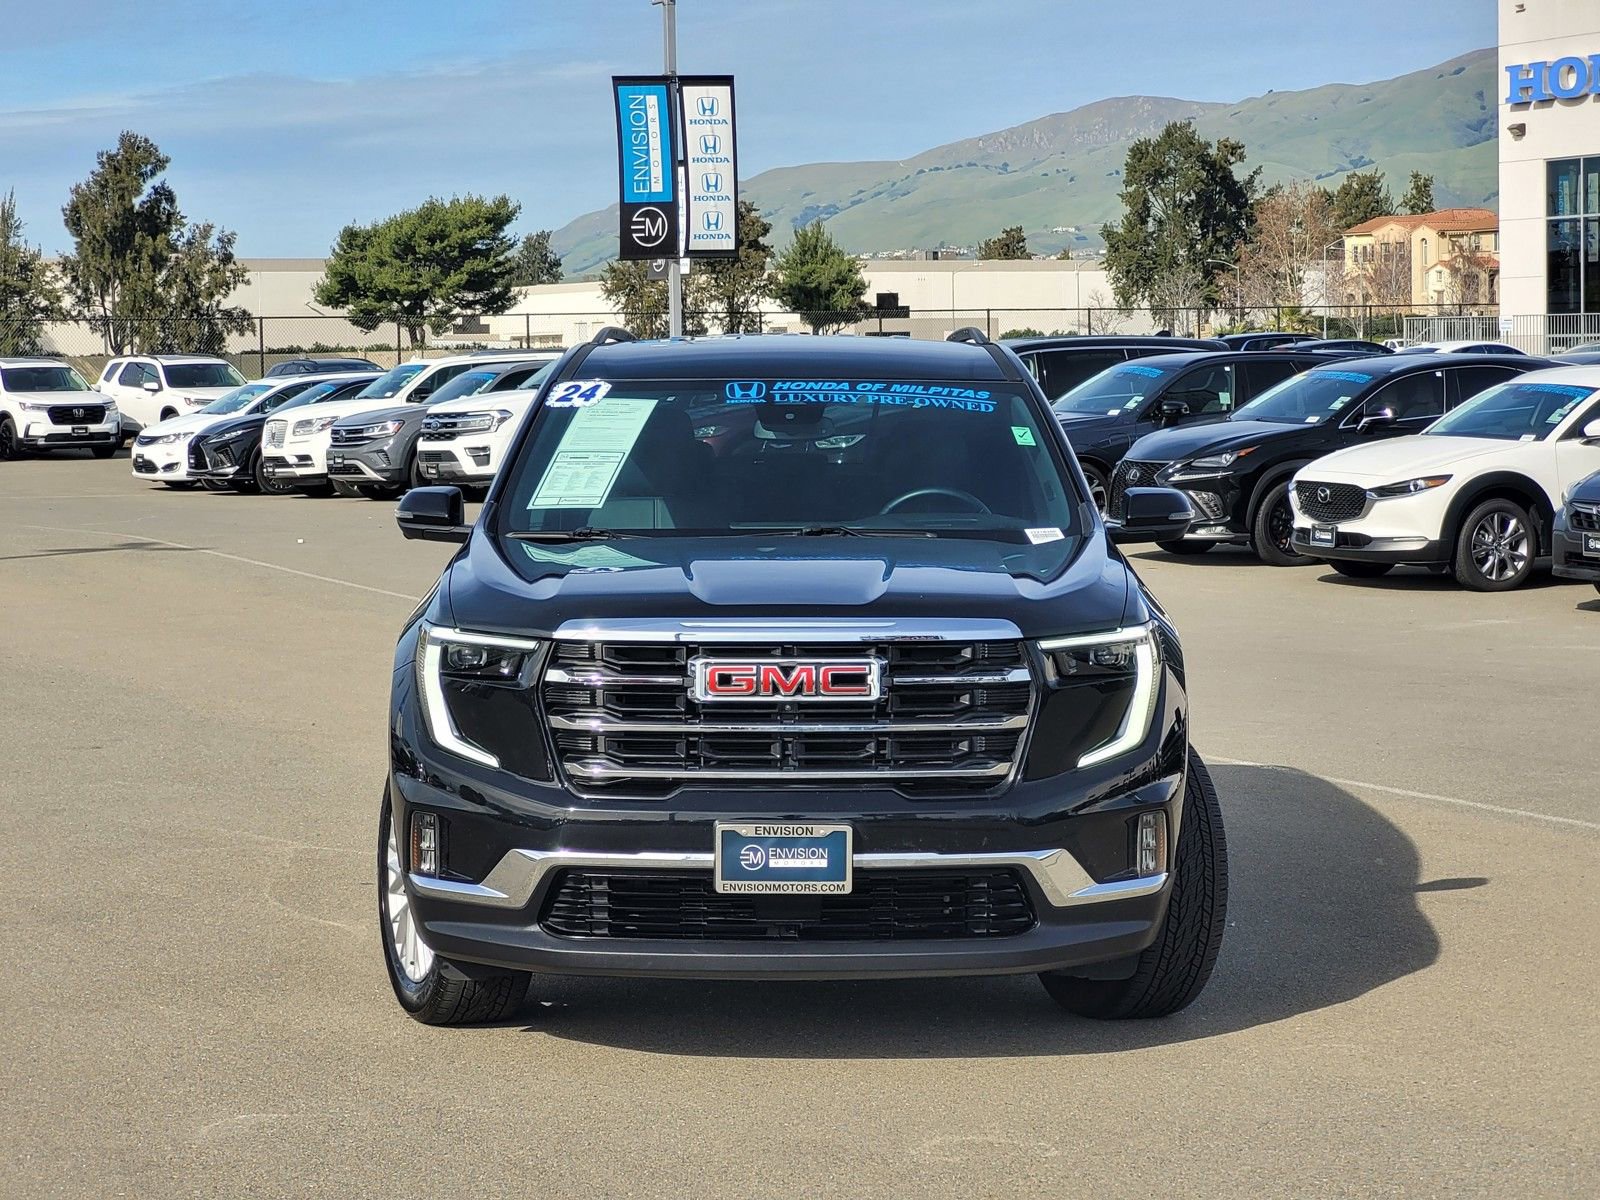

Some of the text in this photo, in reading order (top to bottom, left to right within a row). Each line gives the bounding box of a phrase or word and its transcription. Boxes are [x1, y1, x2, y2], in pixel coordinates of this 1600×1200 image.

[689, 118, 729, 126] HONDA
[628, 94, 650, 193] ENVISION
[648, 103, 661, 184] MOTORS
[691, 156, 730, 164] HONDA
[693, 194, 731, 202] HONDA
[693, 233, 732, 241] HONDA
[555, 384, 602, 403] 24
[773, 381, 991, 399] HONDA OF MILPITAS
[774, 393, 994, 412] LUXURY PRE-OWNED
[707, 665, 872, 696] GMC
[754, 826, 814, 836] ENVISION
[768, 847, 828, 859] ENVISION
[722, 883, 846, 892] ENVISIONMOTORS.COM
